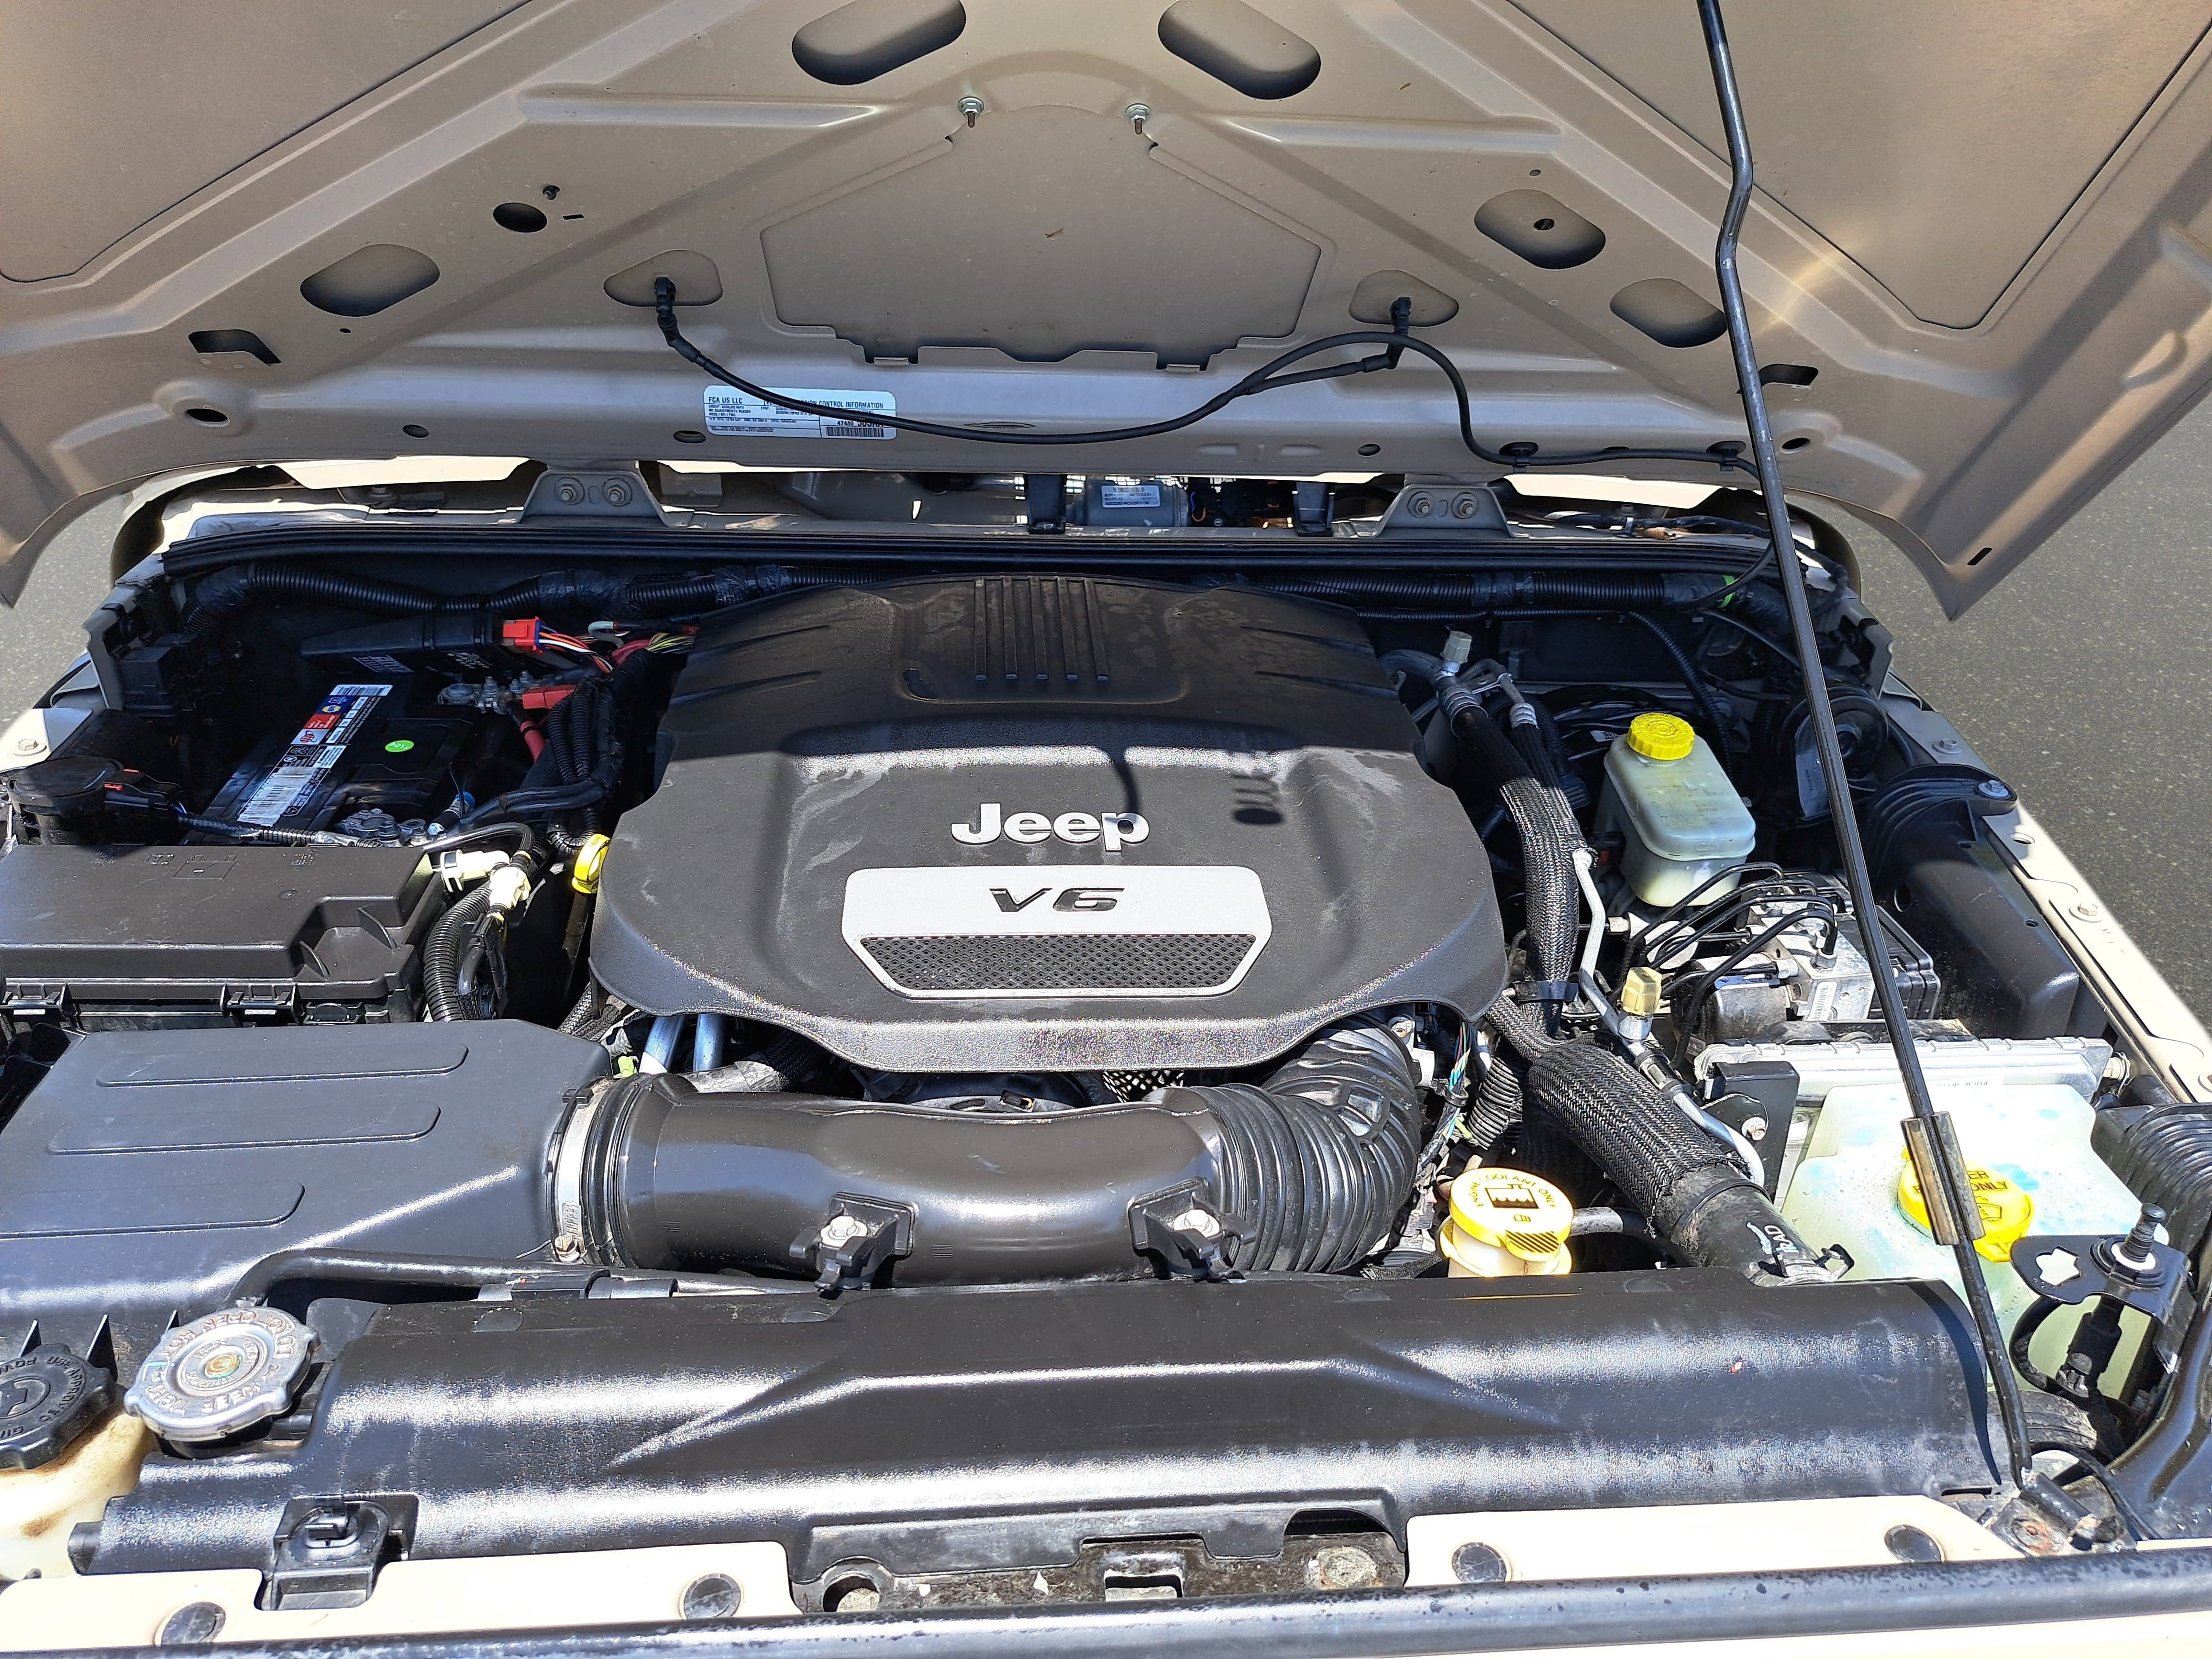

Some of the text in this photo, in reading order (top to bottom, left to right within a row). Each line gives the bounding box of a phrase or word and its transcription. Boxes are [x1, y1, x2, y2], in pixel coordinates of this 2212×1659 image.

[951, 803, 1150, 852] Jeep
[989, 887, 1125, 913] V6
[1469, 1173, 1557, 1208] ENGINE COOLANT ONLY
[1971, 1181, 2009, 1191] ONLY
[1764, 1225, 1800, 1254] RAD
[202, 1311, 257, 1334] OPEN
